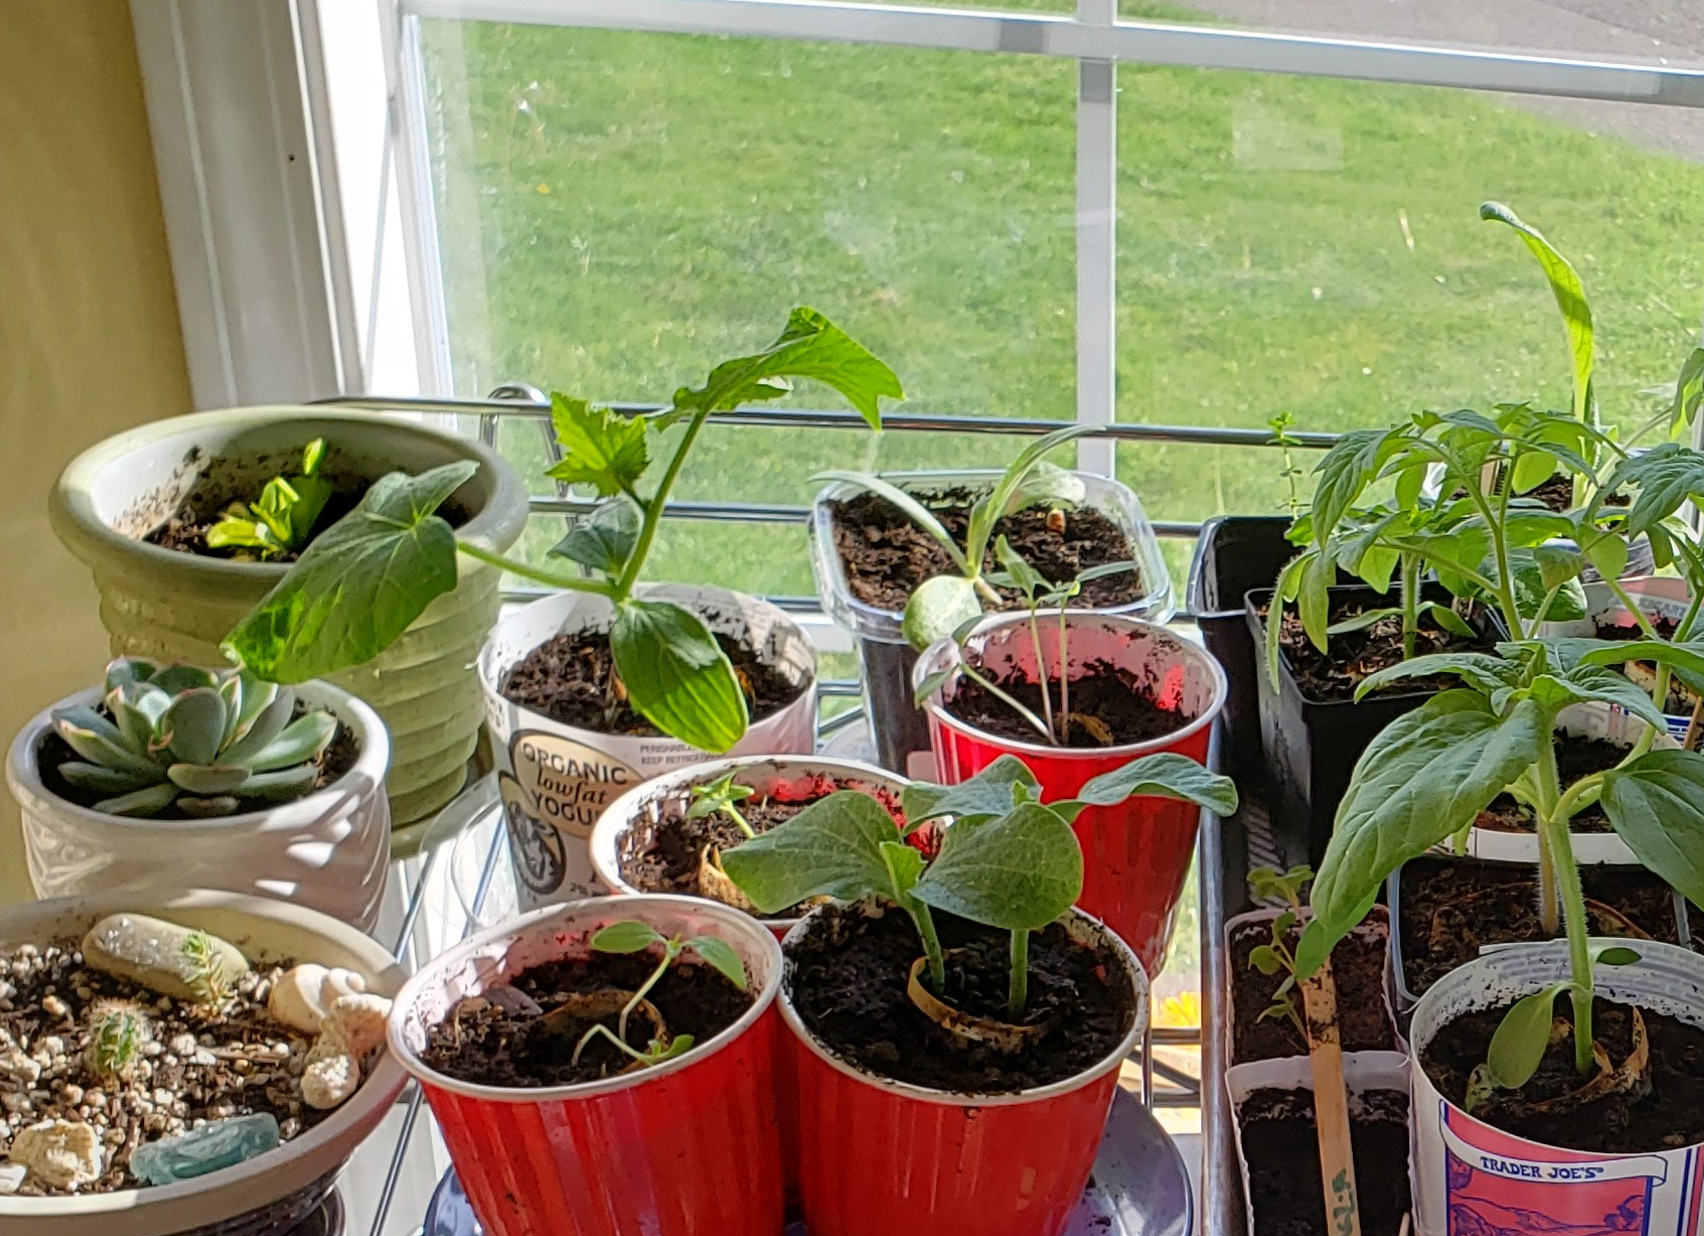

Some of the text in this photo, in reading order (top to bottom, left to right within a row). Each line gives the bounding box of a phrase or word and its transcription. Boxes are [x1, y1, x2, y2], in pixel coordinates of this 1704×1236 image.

[522, 742, 628, 785] ORGANIC
[536, 769, 608, 805] lowfat
[1480, 1156, 1604, 1180] TRADER JOE'S
